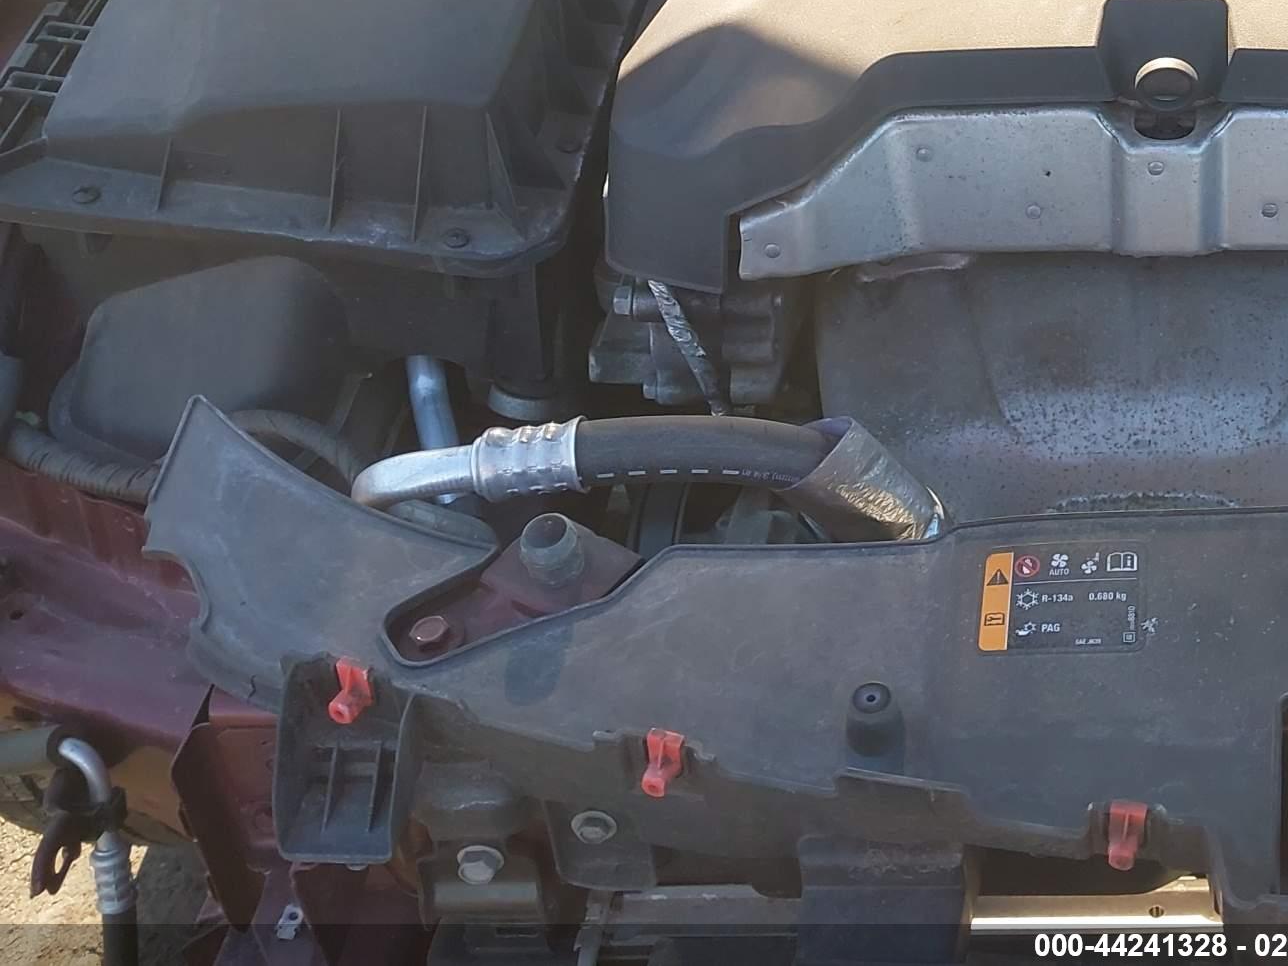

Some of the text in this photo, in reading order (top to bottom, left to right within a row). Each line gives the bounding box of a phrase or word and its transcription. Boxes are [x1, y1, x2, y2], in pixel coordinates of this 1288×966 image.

[1049, 567, 1070, 577] AUTO
[1041, 593, 1074, 603] R-134a
[1115, 591, 1127, 602] kg
[1041, 623, 1061, 633] PAG
